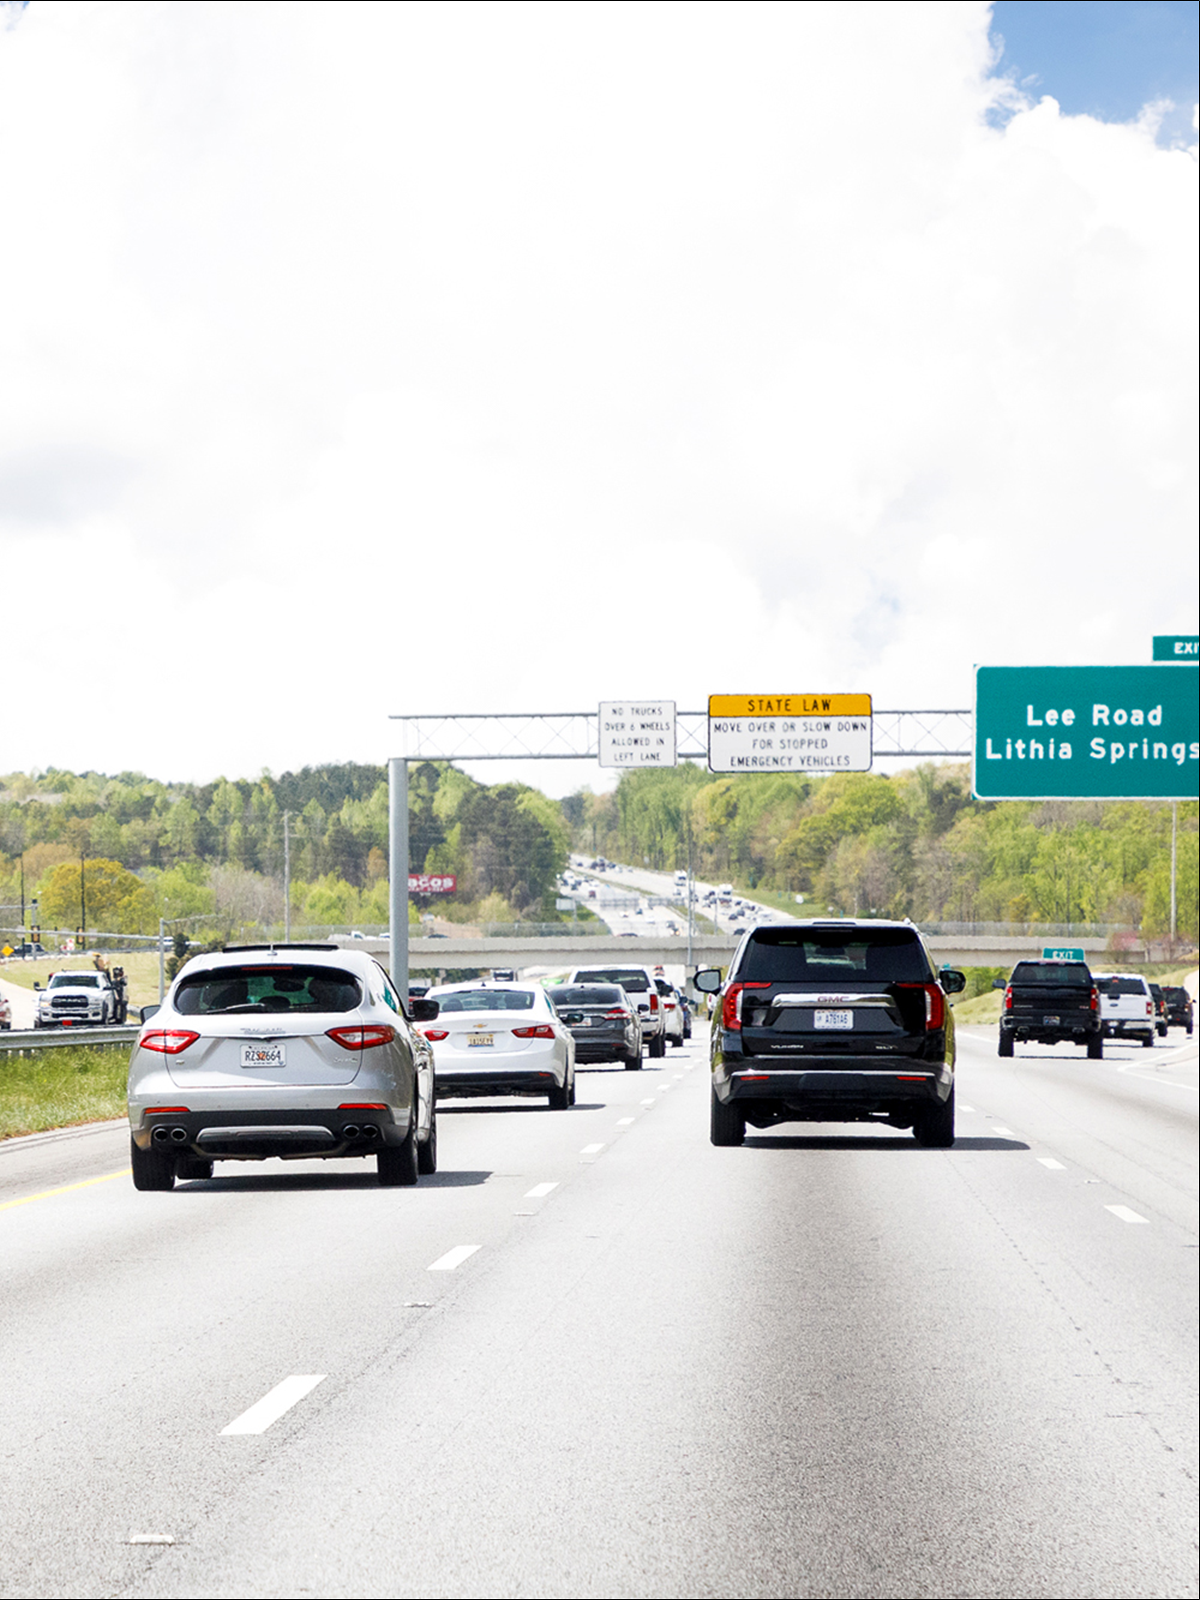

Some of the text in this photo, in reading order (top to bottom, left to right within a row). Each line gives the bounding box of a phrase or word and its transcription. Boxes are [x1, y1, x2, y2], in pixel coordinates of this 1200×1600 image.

[1174, 642, 1199, 654] EXI
[748, 699, 832, 712] STATE LAW
[612, 707, 662, 716] NO TRUCKS
[1027, 704, 1162, 726] Lee Road
[605, 722, 670, 731] OVER 6 WHEELS
[714, 722, 867, 733] MOVE OVER OR SLOW DOWN
[612, 737, 650, 746] ALLOWED
[752, 738, 828, 749] FOR STOPPED
[614, 752, 661, 761] LEFT LANE
[986, 737, 1199, 765] Lithia Springs
[730, 755, 850, 766] EMERGENCY VEHICLES
[1052, 950, 1074, 960] EXIT
